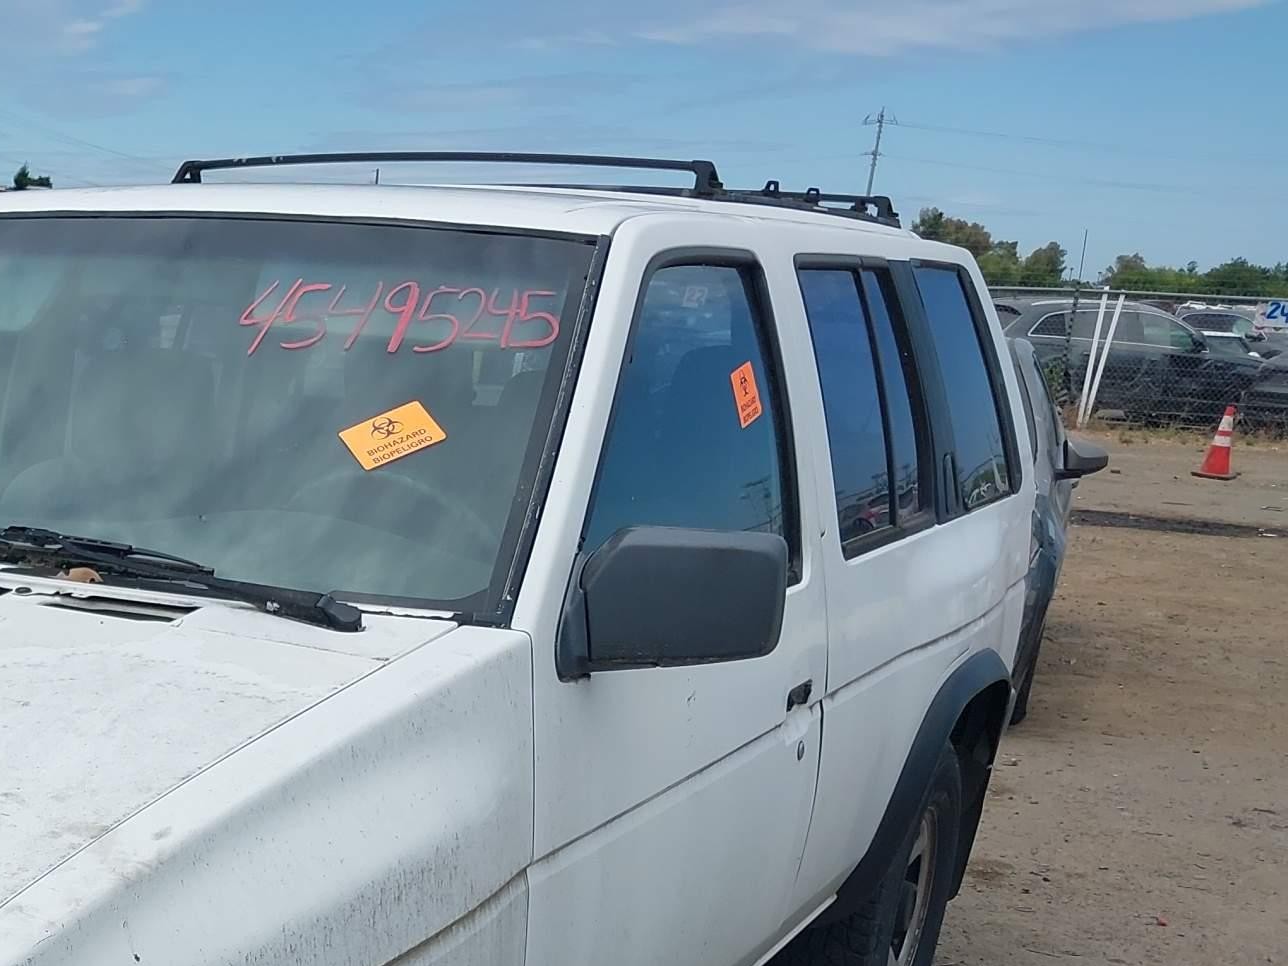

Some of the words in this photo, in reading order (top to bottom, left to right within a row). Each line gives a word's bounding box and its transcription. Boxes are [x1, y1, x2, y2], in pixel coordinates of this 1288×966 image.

[238, 277, 561, 357] 45495245
[366, 428, 427, 457] BIOHAZARD
[372, 435, 434, 464] BIOPELIGRO
